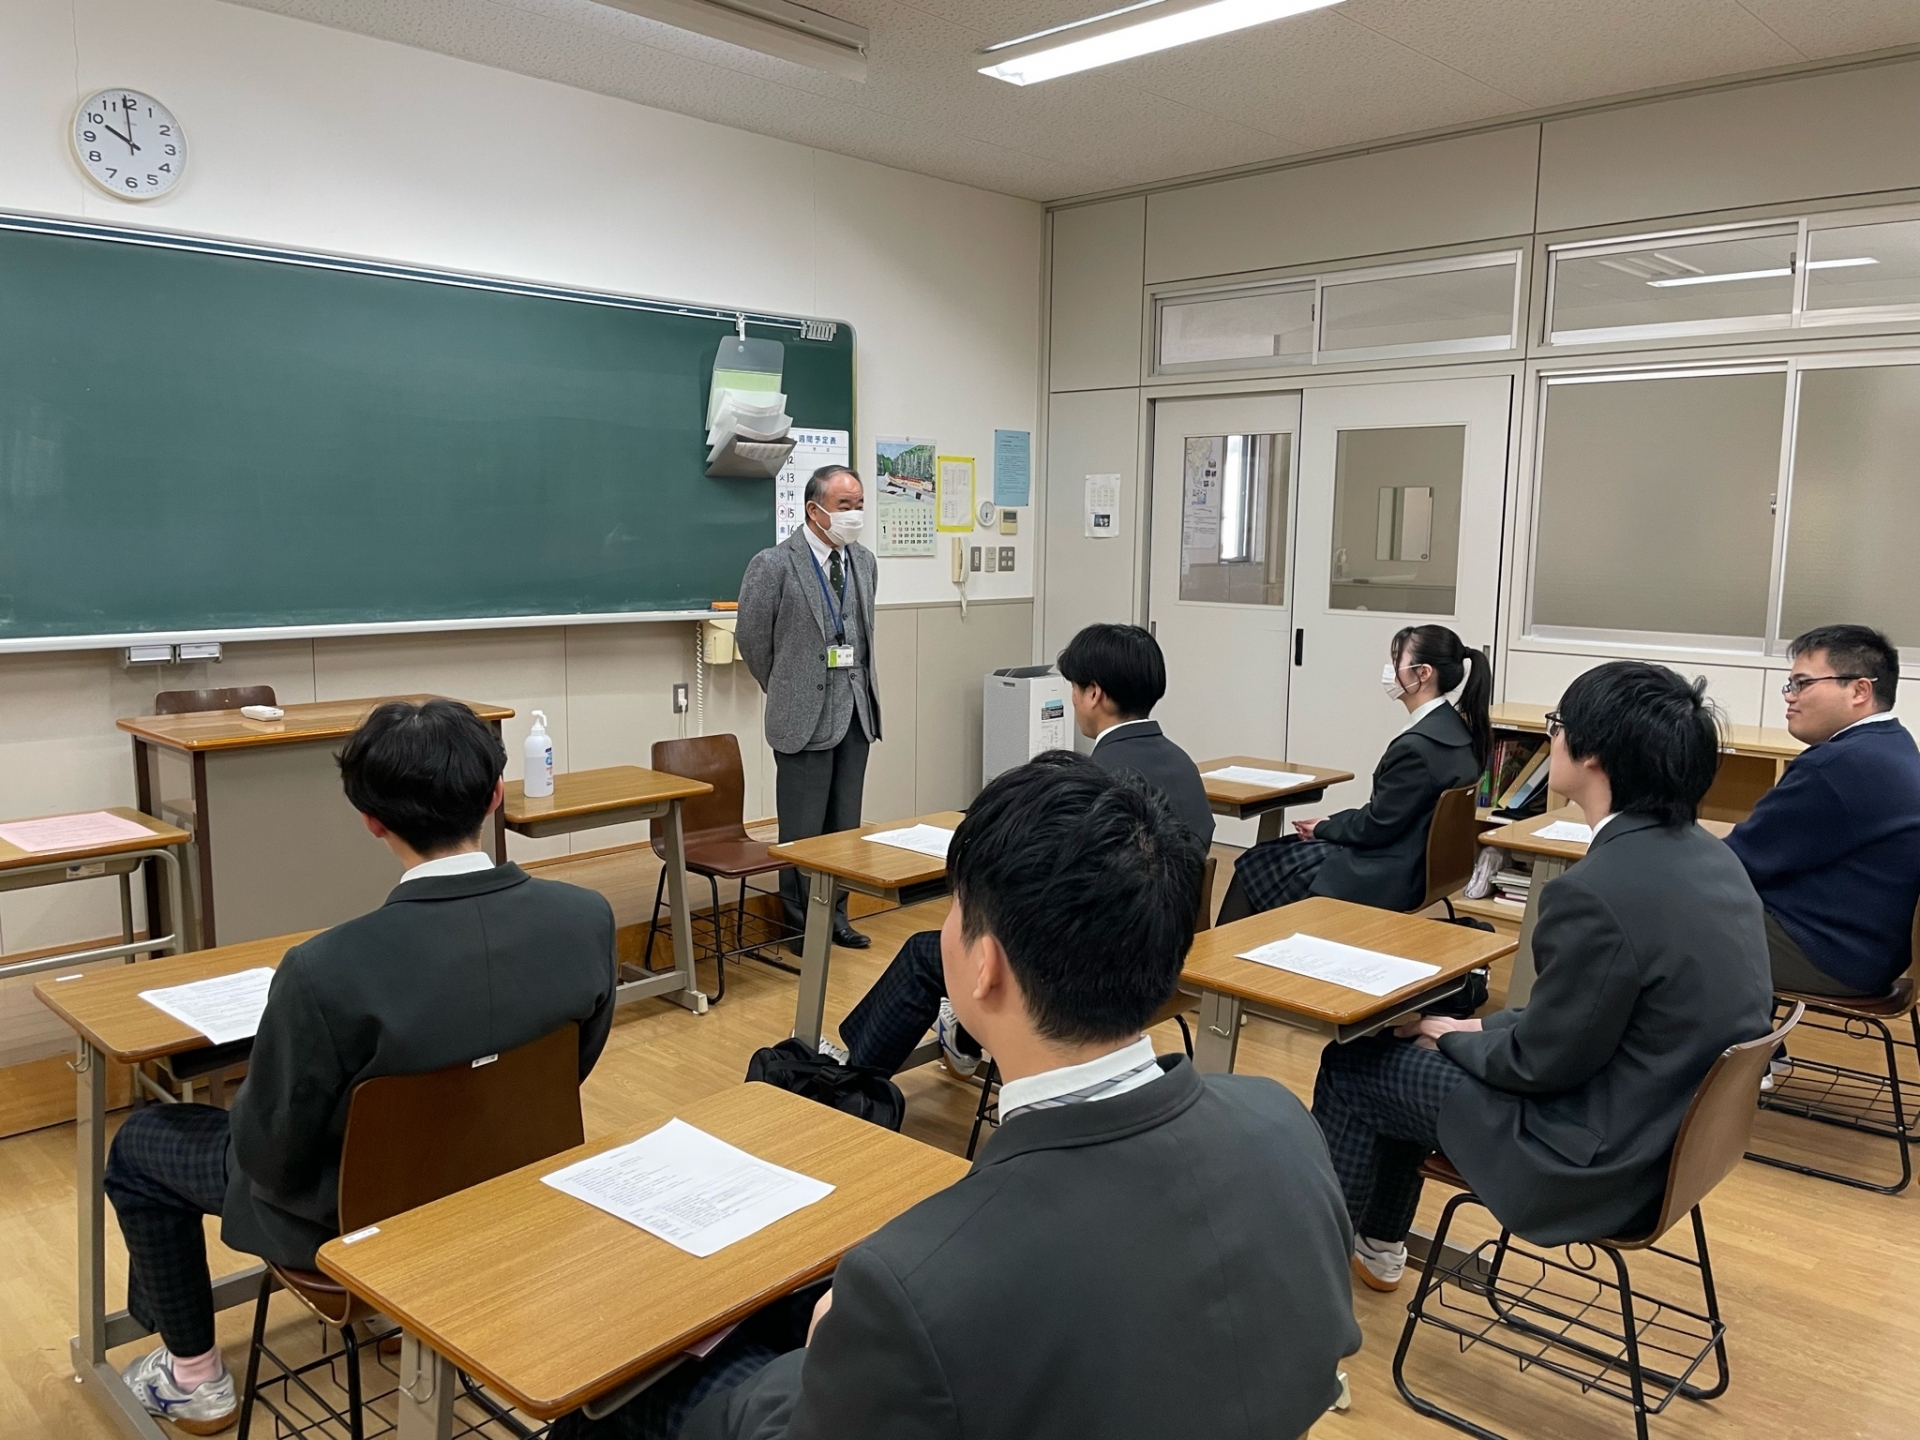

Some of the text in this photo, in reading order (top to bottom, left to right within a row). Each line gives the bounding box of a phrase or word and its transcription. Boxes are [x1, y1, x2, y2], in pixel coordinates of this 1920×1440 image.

[102, 100, 116, 112] 11
[122, 98, 137, 111] 12
[87, 112, 104, 125] 10
[148, 107, 153, 118] 1
[83, 130, 97, 143] 9
[159, 125, 171, 137] 2
[89, 150, 102, 162] 8
[165, 144, 176, 156] 3
[105, 167, 118, 179] 7
[158, 163, 171, 174] 4
[125, 177, 138, 189] 6
[147, 174, 159, 186] 5
[798, 434, 837, 445] 週間予定表
[787, 473, 795, 483] 13
[787, 491, 795, 501] 14
[787, 508, 795, 519] 15
